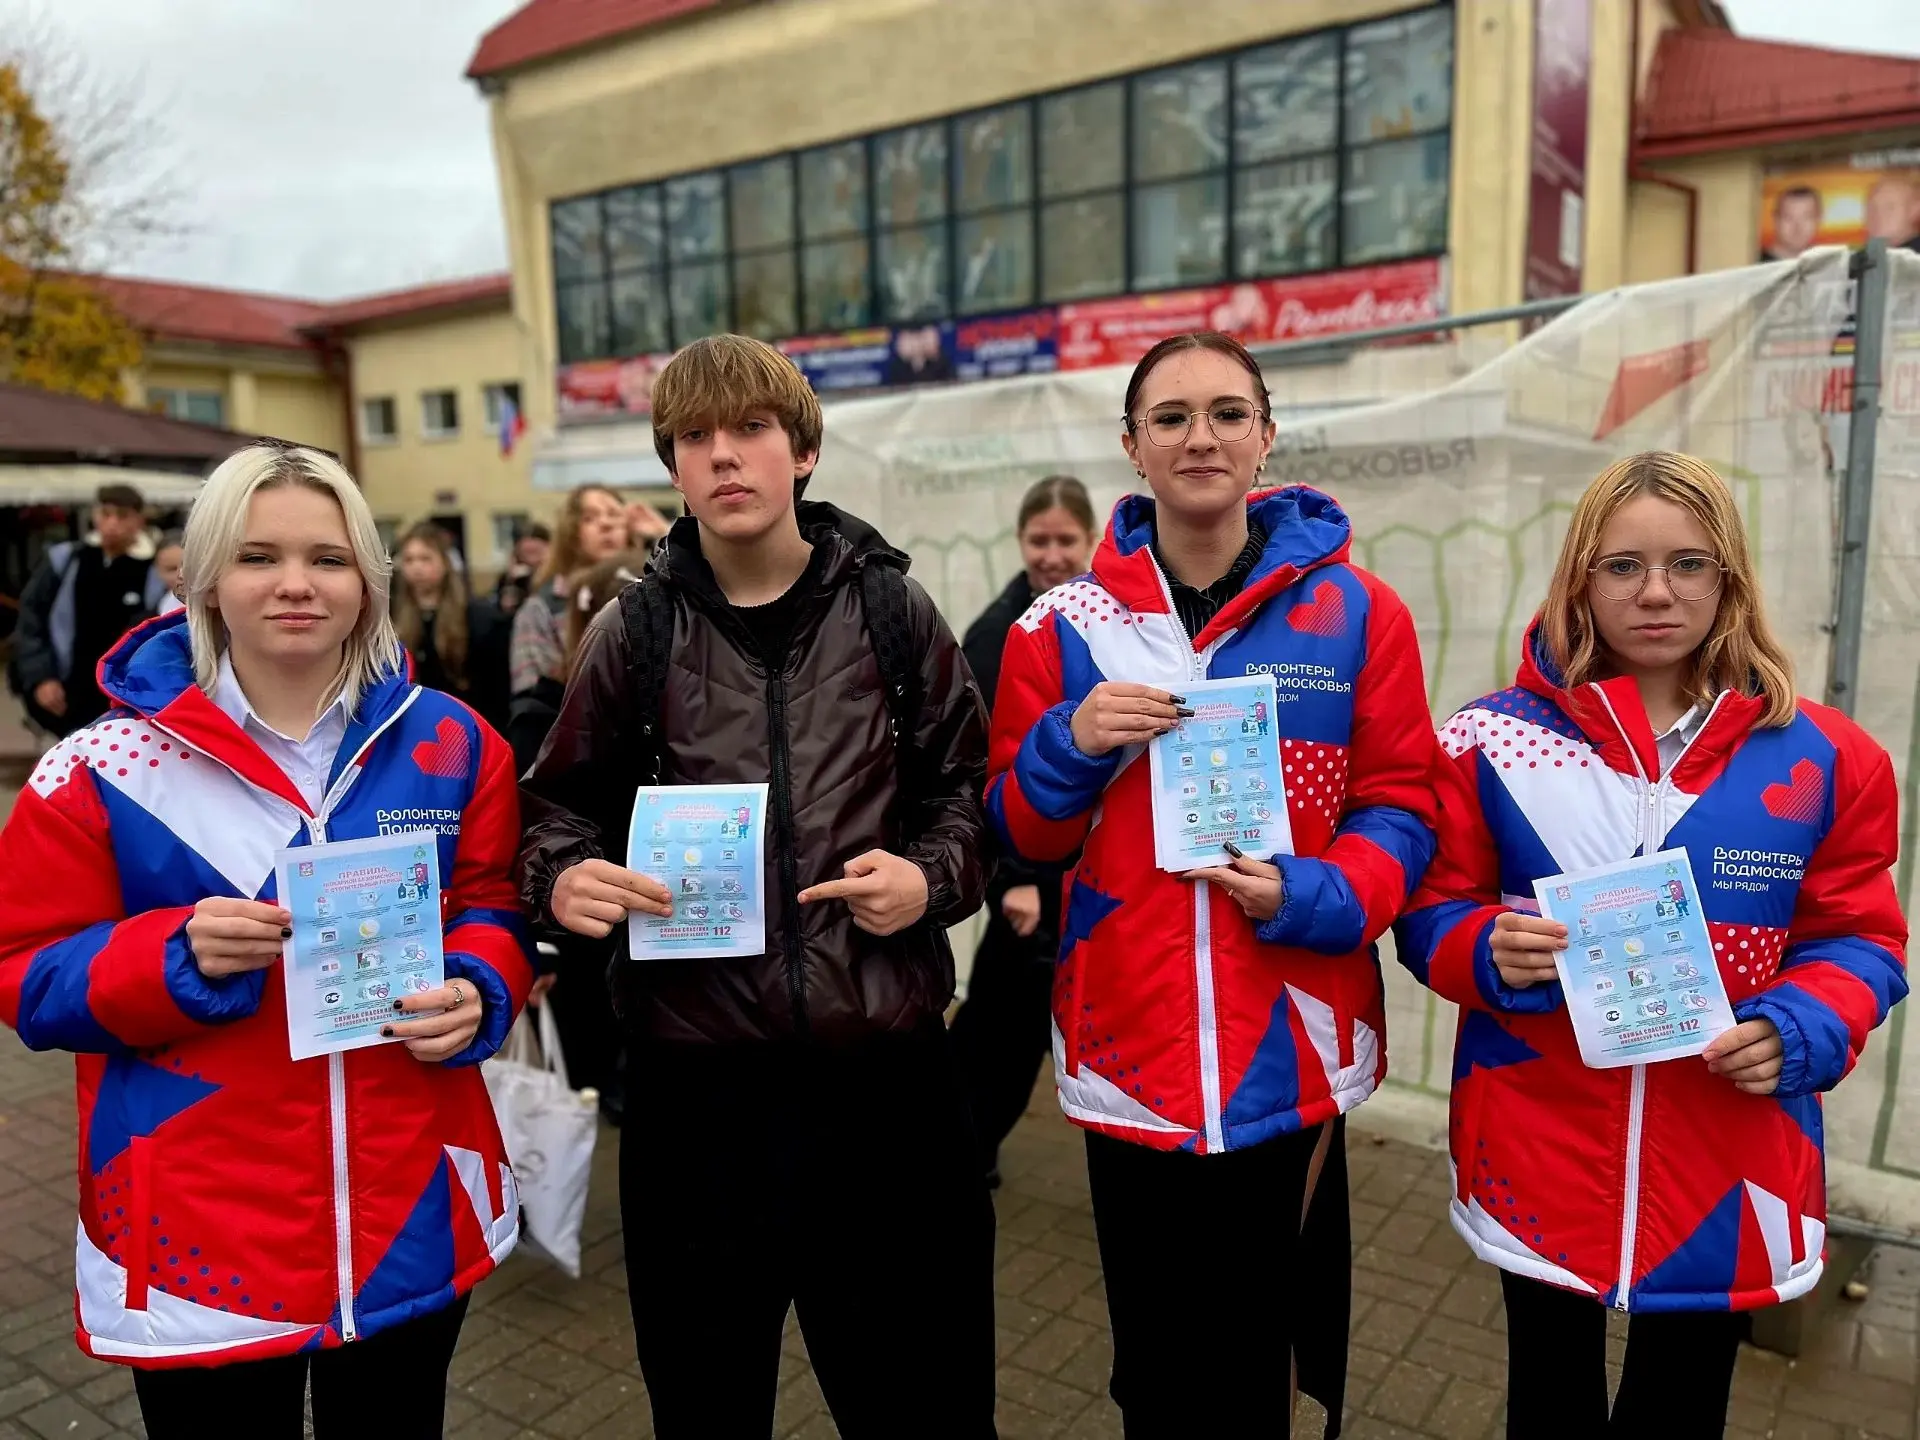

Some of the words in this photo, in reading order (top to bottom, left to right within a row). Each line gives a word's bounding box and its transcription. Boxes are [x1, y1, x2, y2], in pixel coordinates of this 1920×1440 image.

[1265, 436, 1475, 484] МОСКОВЬЯ
[1277, 678, 1351, 693] МОСКОВЬЯ
[1277, 693, 1299, 703] ДОМ
[1243, 828, 1261, 839] 112
[338, 866, 389, 879] ПРАВИЛА
[1712, 880, 1733, 890] МЫ
[1735, 881, 1769, 892] РЯДОМ
[1594, 886, 1641, 901] ПРАВИЛА
[712, 925, 731, 936] 112
[1679, 1018, 1700, 1032] 112
